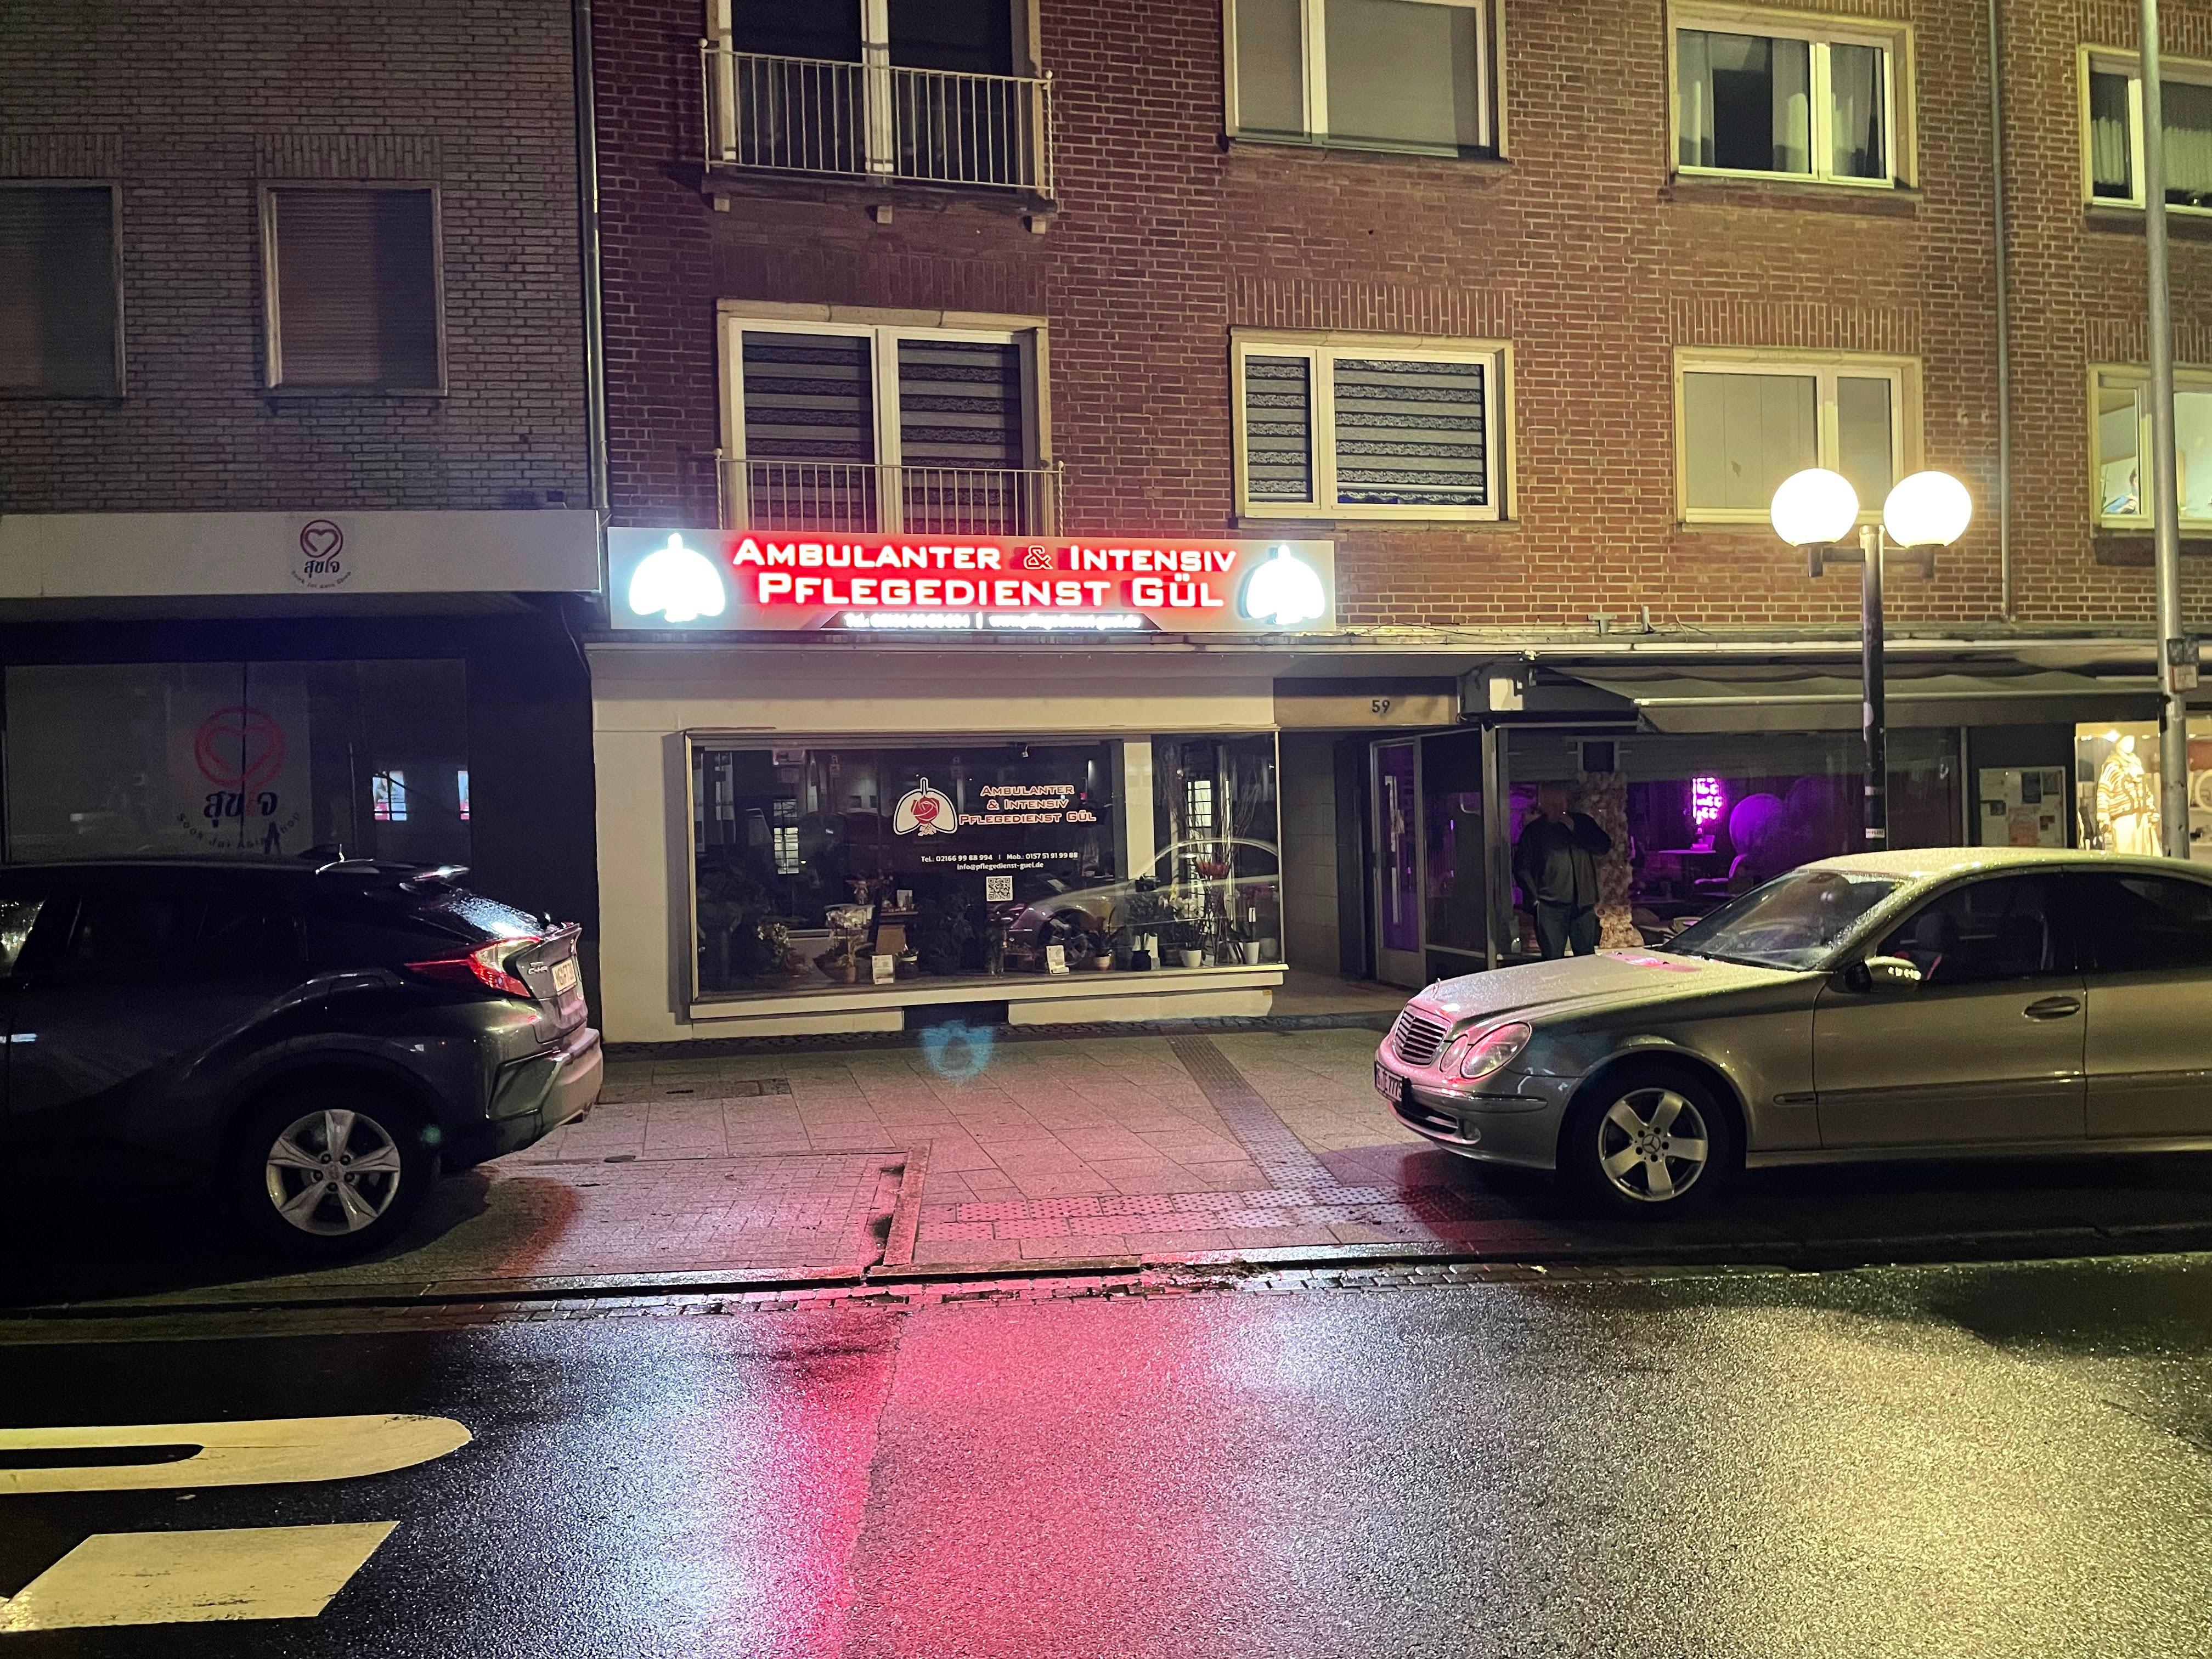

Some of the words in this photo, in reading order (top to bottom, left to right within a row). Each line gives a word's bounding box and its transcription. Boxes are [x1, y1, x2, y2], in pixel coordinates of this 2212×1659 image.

[732, 539, 1002, 569] AMBULANTER
[1023, 545, 1053, 570] &
[1070, 545, 1238, 572] INTENSIV
[758, 572, 1111, 607] PFLEGEDIENST
[1132, 573, 1224, 607] GÜL
[1372, 699, 1390, 713] 59
[980, 785, 1075, 797] AMBULANTER
[987, 799, 1000, 810] &
[1004, 799, 1069, 810] INTENSIV
[958, 812, 1062, 826] PFLEGEDIENST
[1066, 809, 1097, 823] GÜL
